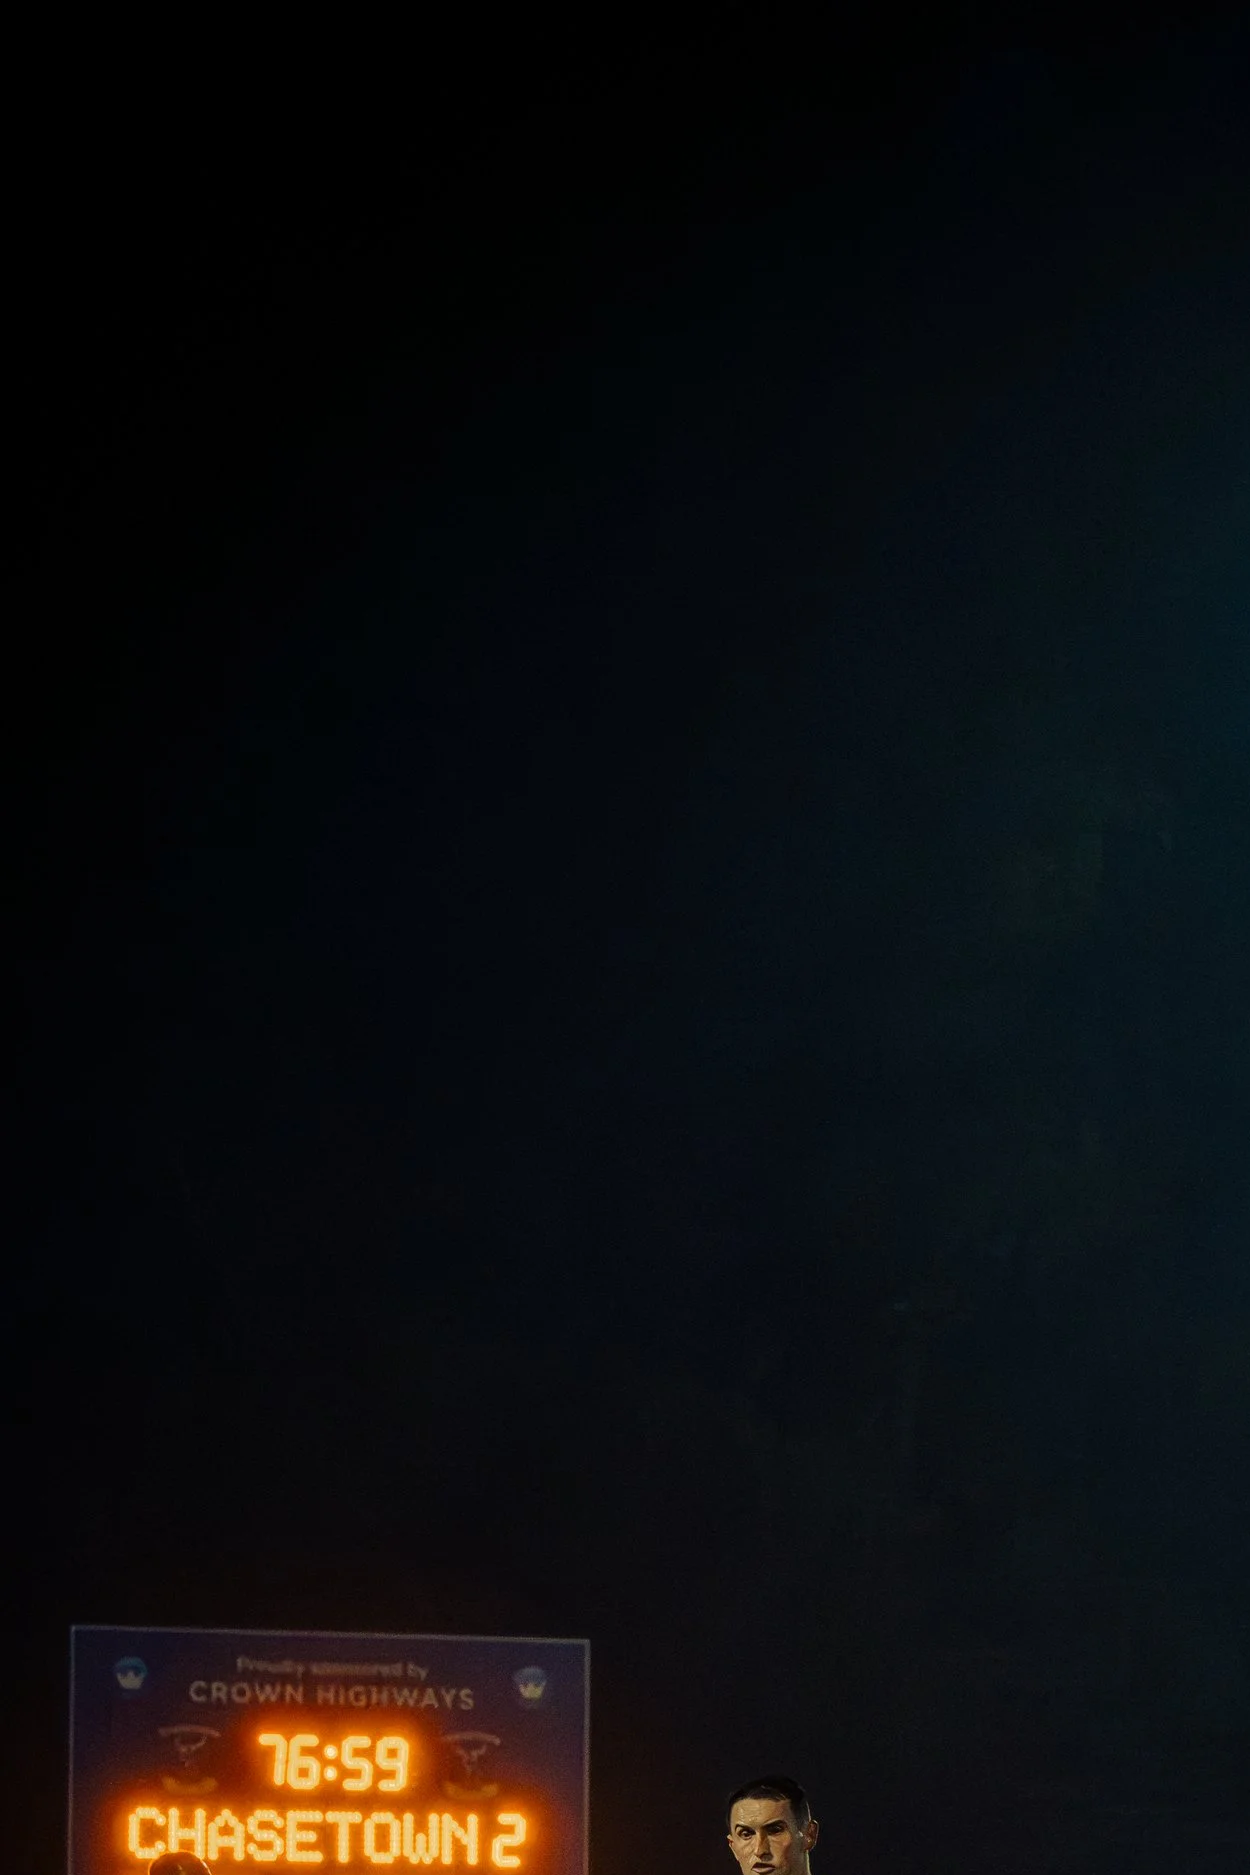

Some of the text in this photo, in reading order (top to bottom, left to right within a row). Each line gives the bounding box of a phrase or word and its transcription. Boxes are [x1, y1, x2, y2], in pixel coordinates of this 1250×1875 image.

[188, 1680, 475, 1711] CROWN HIGHWAYS
[257, 1732, 410, 1792] 76:59
[127, 1806, 528, 1869] CHASETOWN 2
